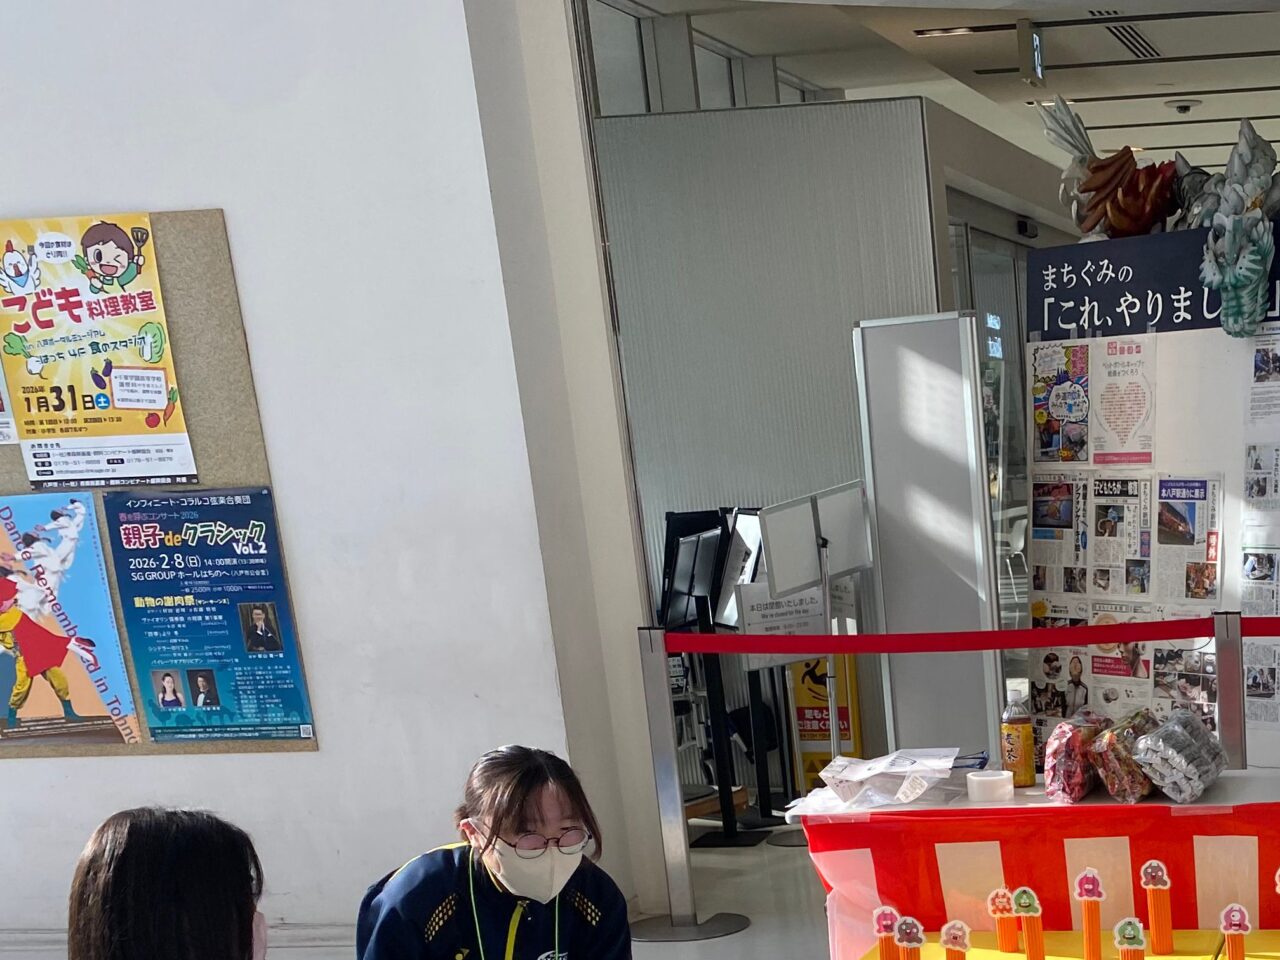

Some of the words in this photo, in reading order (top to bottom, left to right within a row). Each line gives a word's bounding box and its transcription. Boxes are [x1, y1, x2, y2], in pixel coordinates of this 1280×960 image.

[1042, 258, 1134, 291] まちぐみの
[2, 287, 157, 333] こども料理教室
[1042, 279, 1280, 332] 「これ、やりまし」
[88, 336, 147, 354] 食のスタジオ
[24, 384, 95, 413] 1月31日
[120, 520, 266, 549] 親子deクラシック
[147, 572, 176, 581] GROUP
[178, 570, 230, 579] ホールはちのへ
[30, 563, 102, 675] Remembed
[94, 675, 109, 694] in
